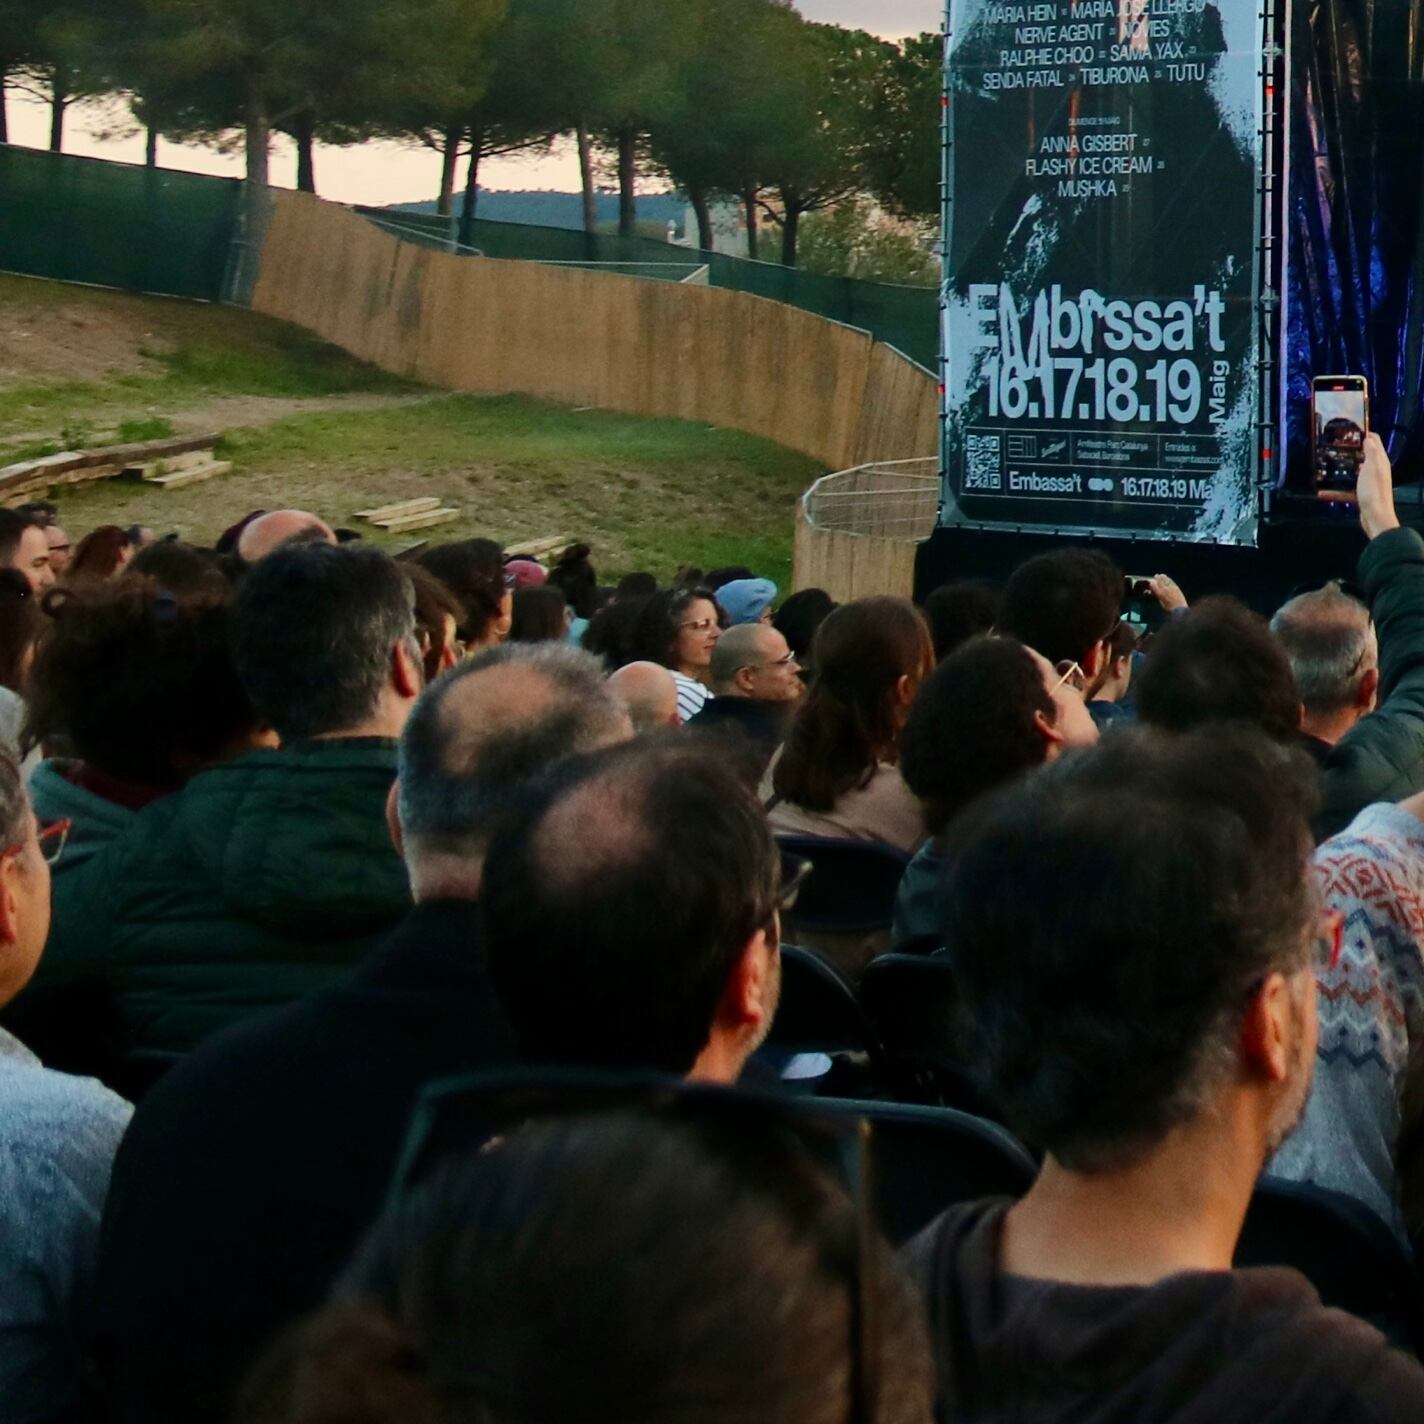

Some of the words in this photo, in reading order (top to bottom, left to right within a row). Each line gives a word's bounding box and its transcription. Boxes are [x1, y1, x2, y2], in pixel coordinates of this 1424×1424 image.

[1027, 3, 1057, 22] HEIN
[1015, 25, 1057, 45] NERVE
[1058, 22, 1105, 43] AGENT
[1000, 47, 1053, 67] RALPHIE
[1054, 45, 1095, 65] CHOO
[1110, 42, 1153, 62] SAMA
[1155, 41, 1184, 60] YAX
[983, 71, 1025, 90] SENDA
[1026, 69, 1065, 88] FATAL
[1079, 65, 1150, 86] TIBURONA
[1166, 63, 1206, 83] TUTU
[1040, 134, 1081, 153] ANNA
[1082, 133, 1138, 153] GISBERT
[1025, 157, 1078, 176] FLASHY
[1079, 156, 1101, 175] ICE
[1102, 155, 1153, 174] CREAM
[1058, 179, 1118, 197] MUSHKA
[982, 357, 1202, 425] 16.17.18.19
[1208, 359, 1231, 424] Maig
[1120, 476, 1188, 499] 16.17.18.19
